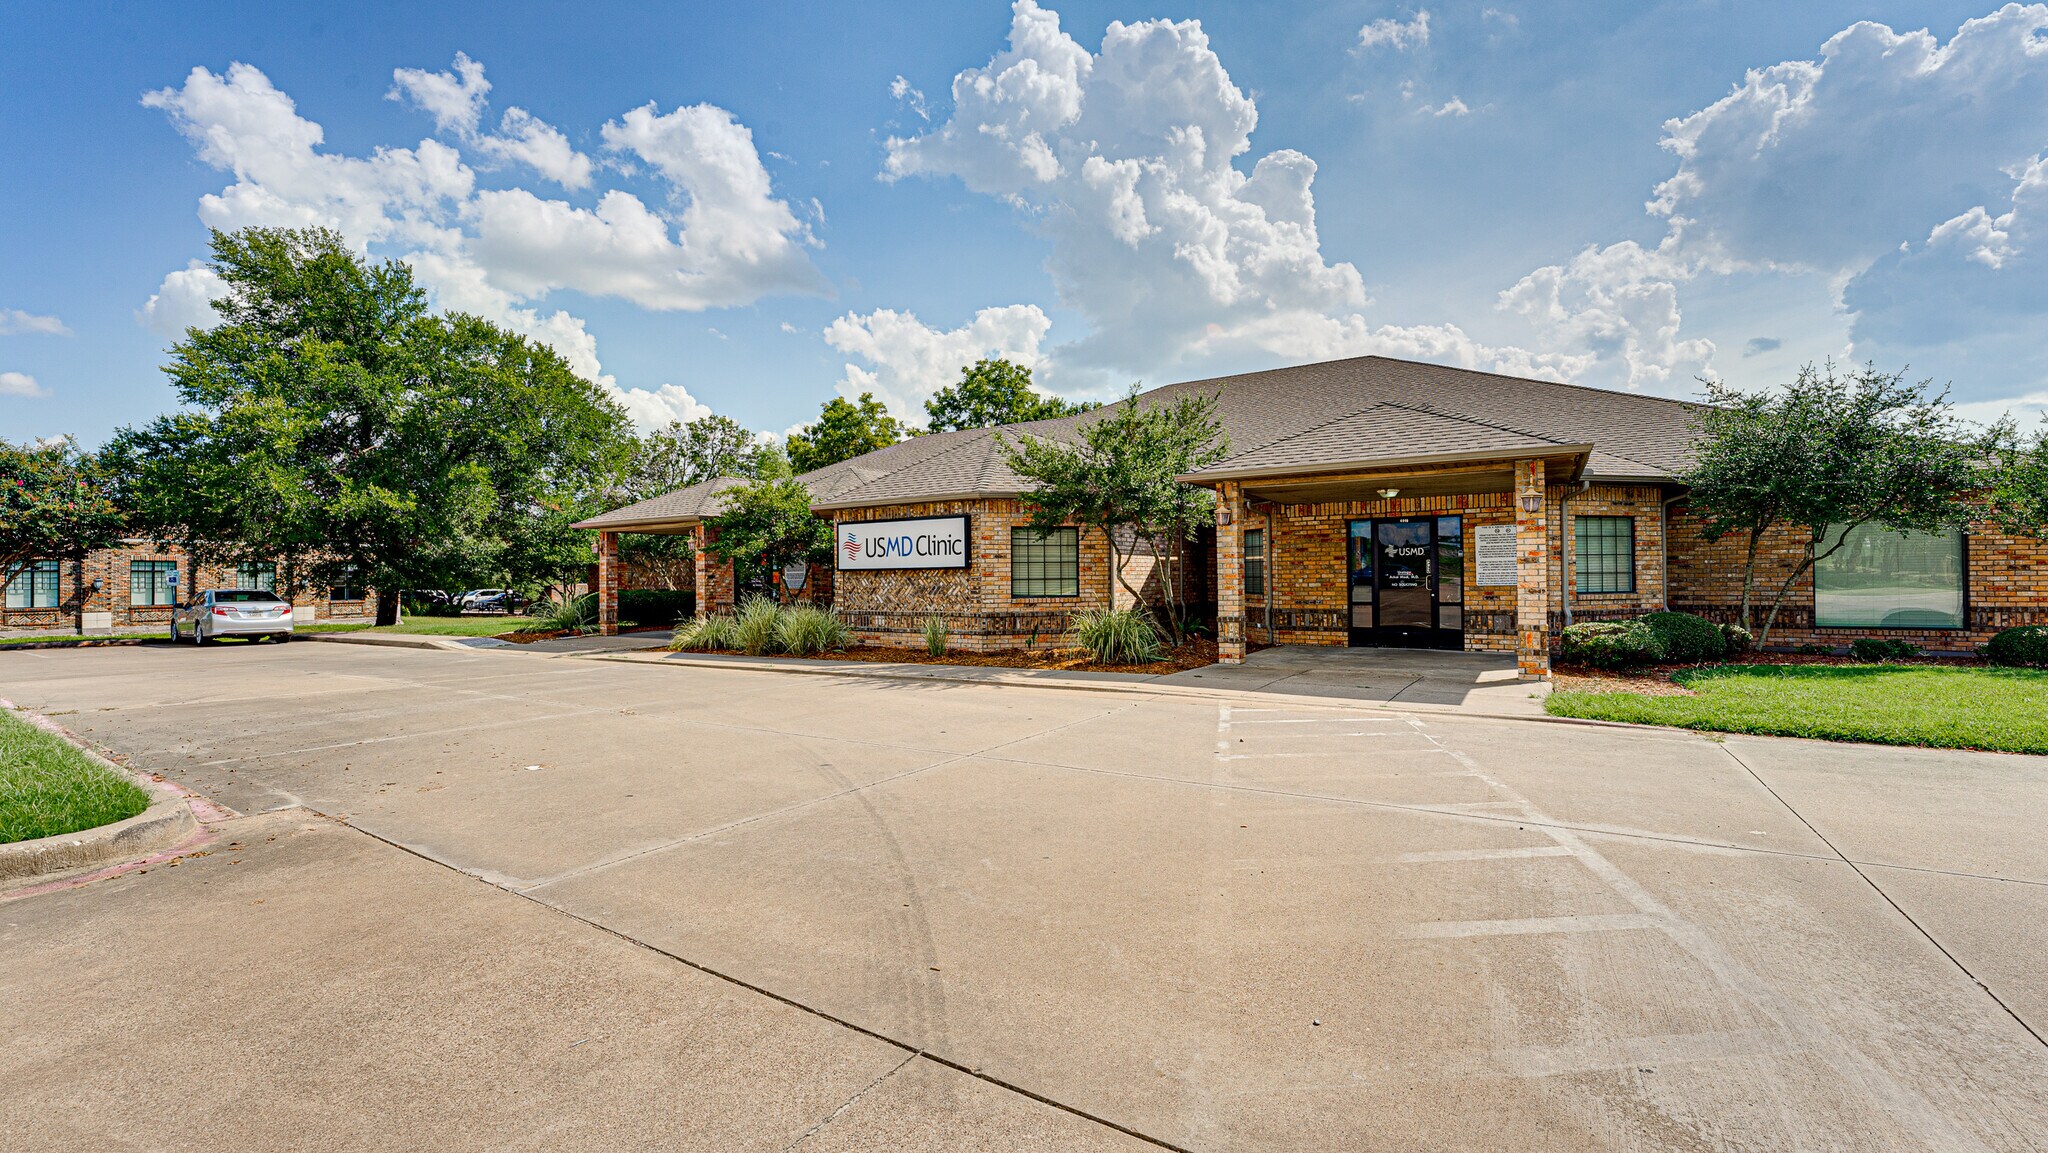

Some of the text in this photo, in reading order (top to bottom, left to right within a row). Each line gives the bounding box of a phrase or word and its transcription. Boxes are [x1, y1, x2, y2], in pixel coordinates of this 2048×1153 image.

[865, 534, 962, 558] USMD Clinic
[1398, 547, 1425, 556] USMD
